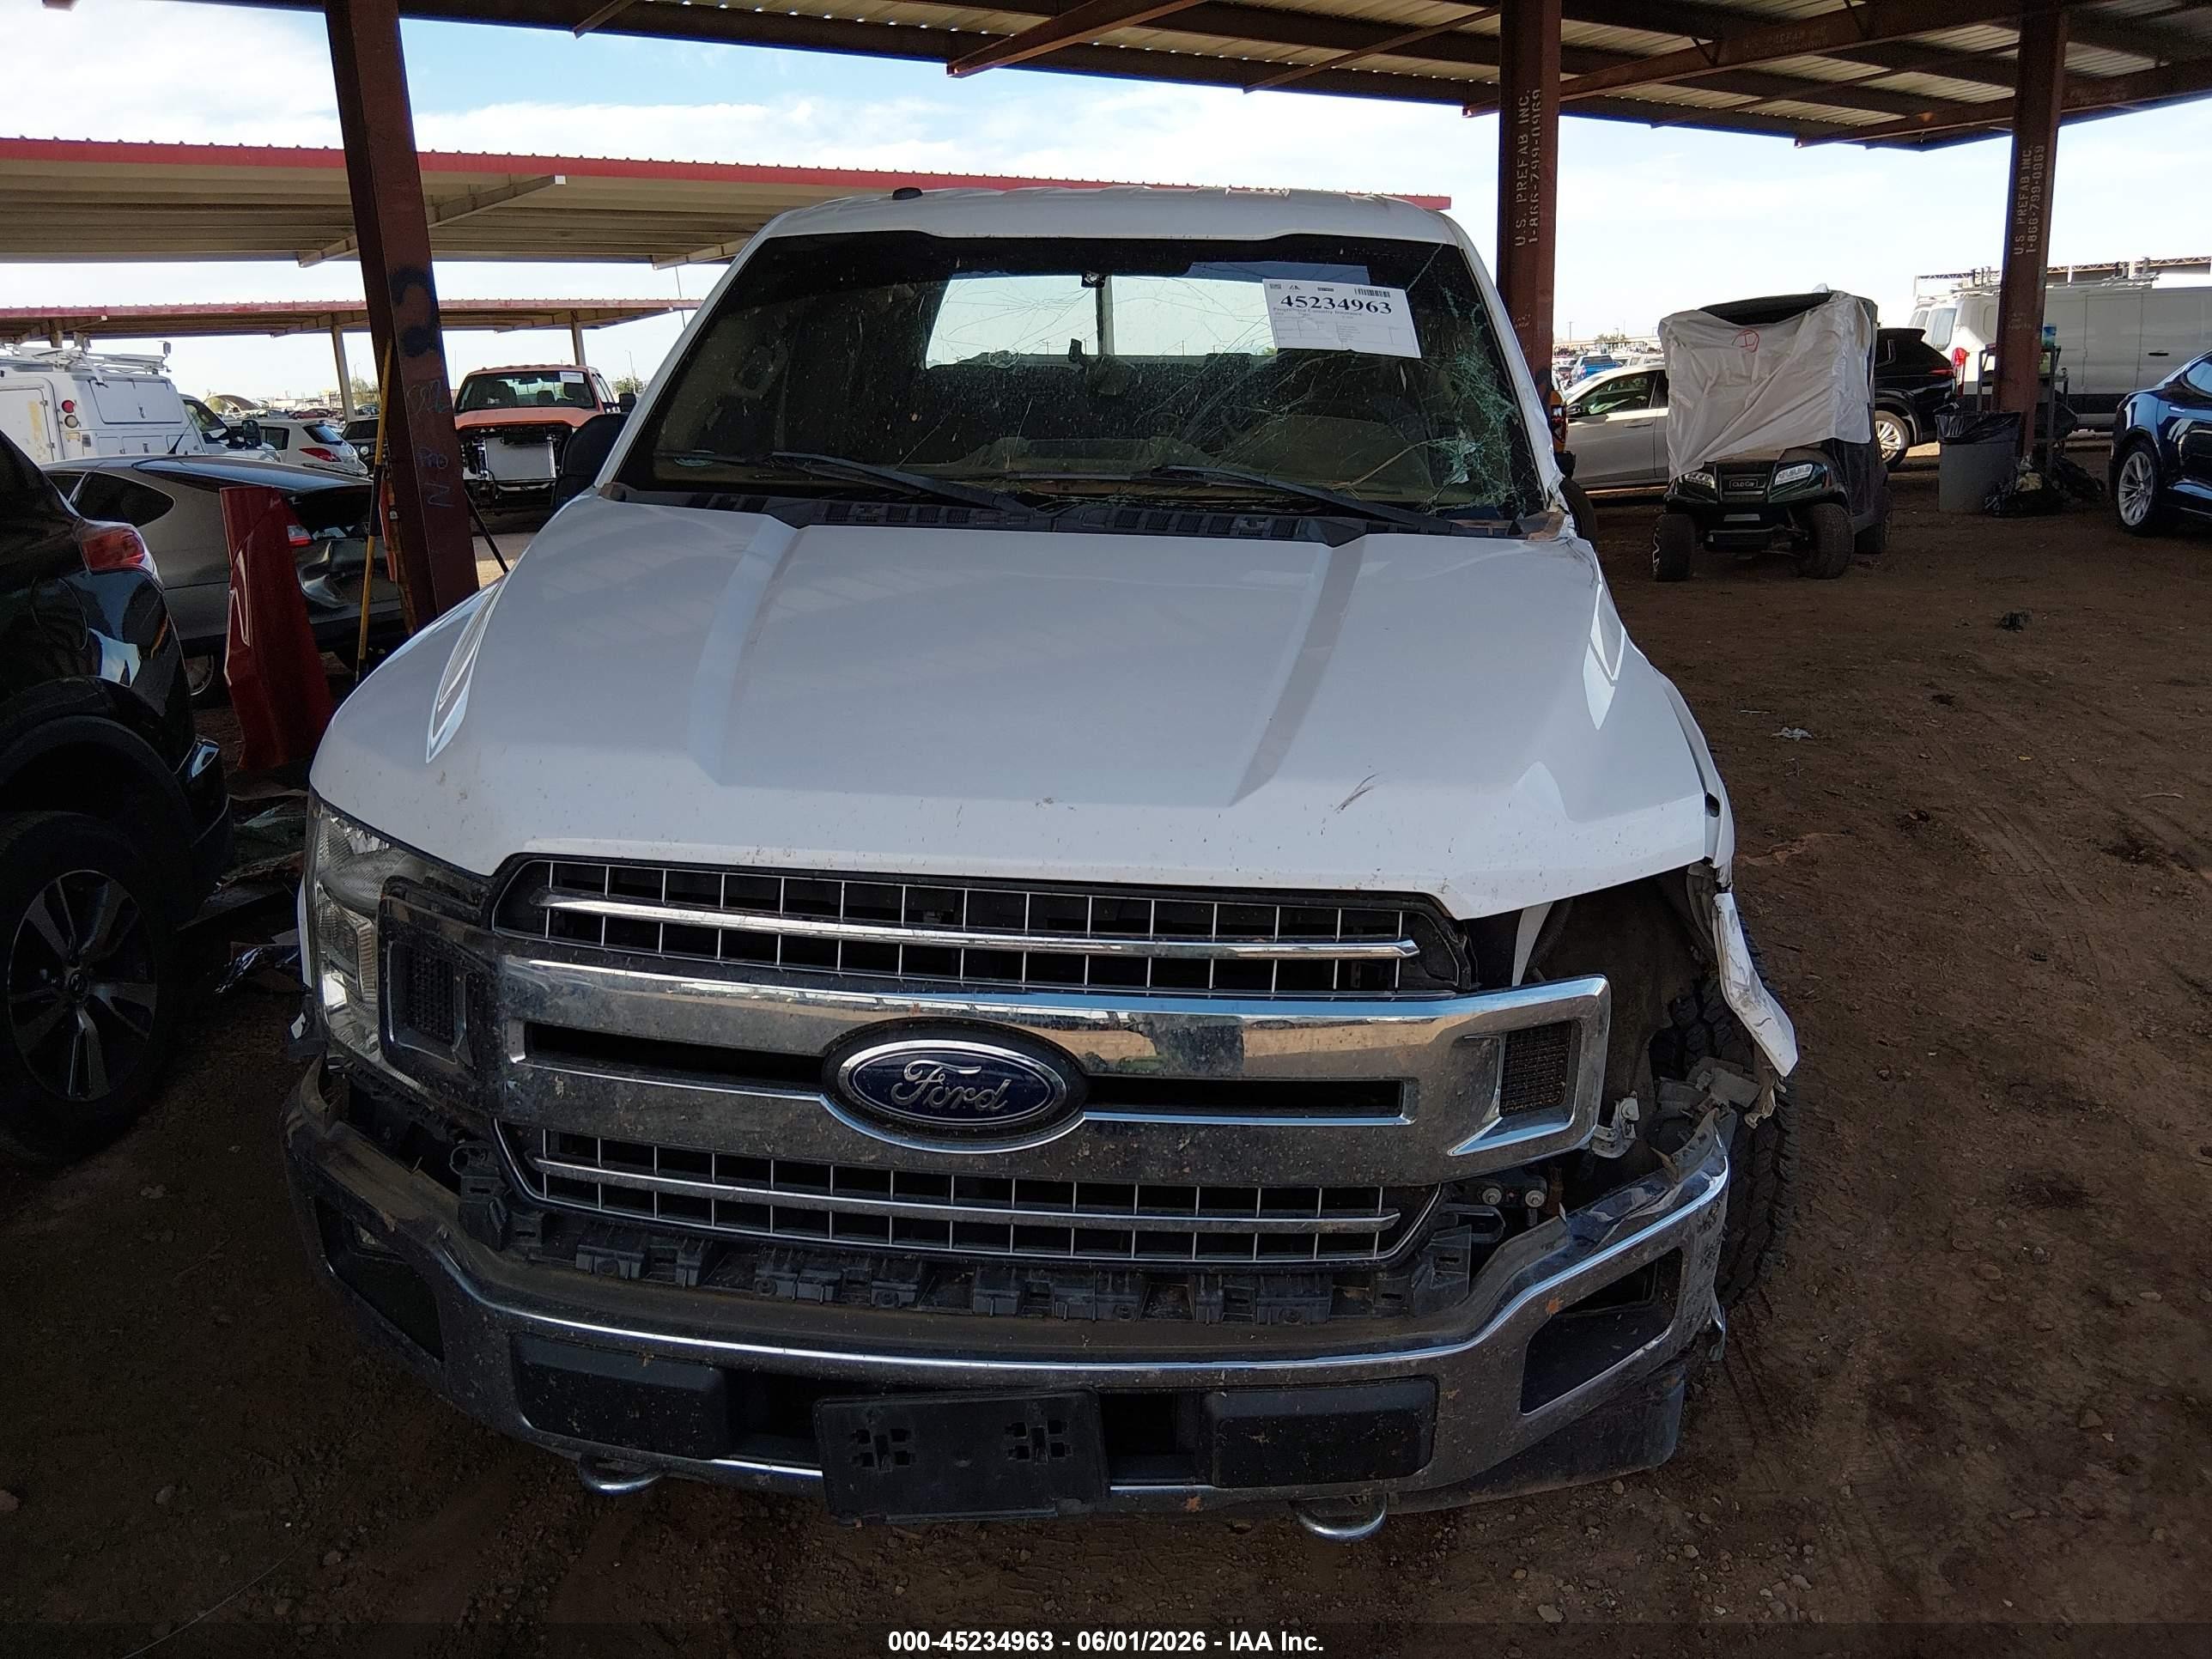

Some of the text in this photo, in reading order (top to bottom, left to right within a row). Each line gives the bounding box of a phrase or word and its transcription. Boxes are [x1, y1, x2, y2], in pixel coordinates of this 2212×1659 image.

[1514, 89, 1530, 246] U.S. PREFAB INC.
[2016, 175, 2030, 225] PREFAB
[2026, 145, 2045, 252] 1-866-799-0969
[1280, 295, 1392, 314] 45234963
[890, 1059, 1012, 1113] Ford
